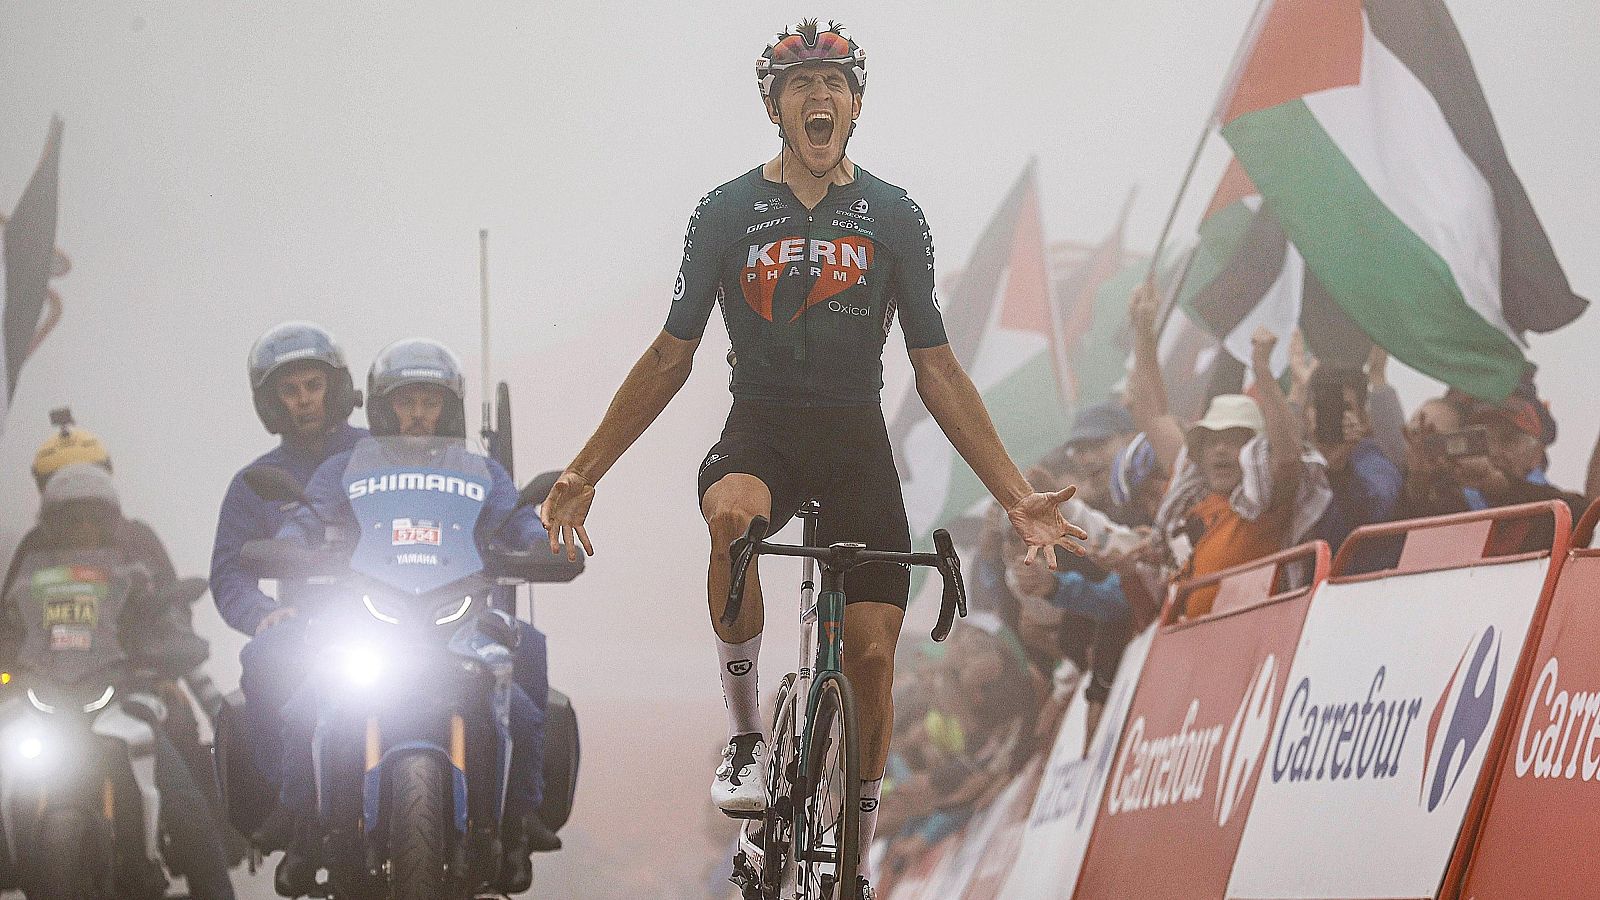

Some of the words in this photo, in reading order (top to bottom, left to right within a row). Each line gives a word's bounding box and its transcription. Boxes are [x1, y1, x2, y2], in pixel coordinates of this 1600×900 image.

[746, 216, 791, 234] GIANT
[831, 219, 853, 229] BCD
[747, 238, 868, 271] KERN
[747, 266, 867, 286] PHARMA
[828, 301, 872, 317] Oxicol
[348, 472, 486, 502] SHIMANO
[398, 528, 434, 543] 5754
[397, 553, 437, 565] YAMAHA
[1272, 666, 1423, 783] Carrefour
[1515, 657, 1600, 782] Carre
[1107, 698, 1224, 816] Carrefour
